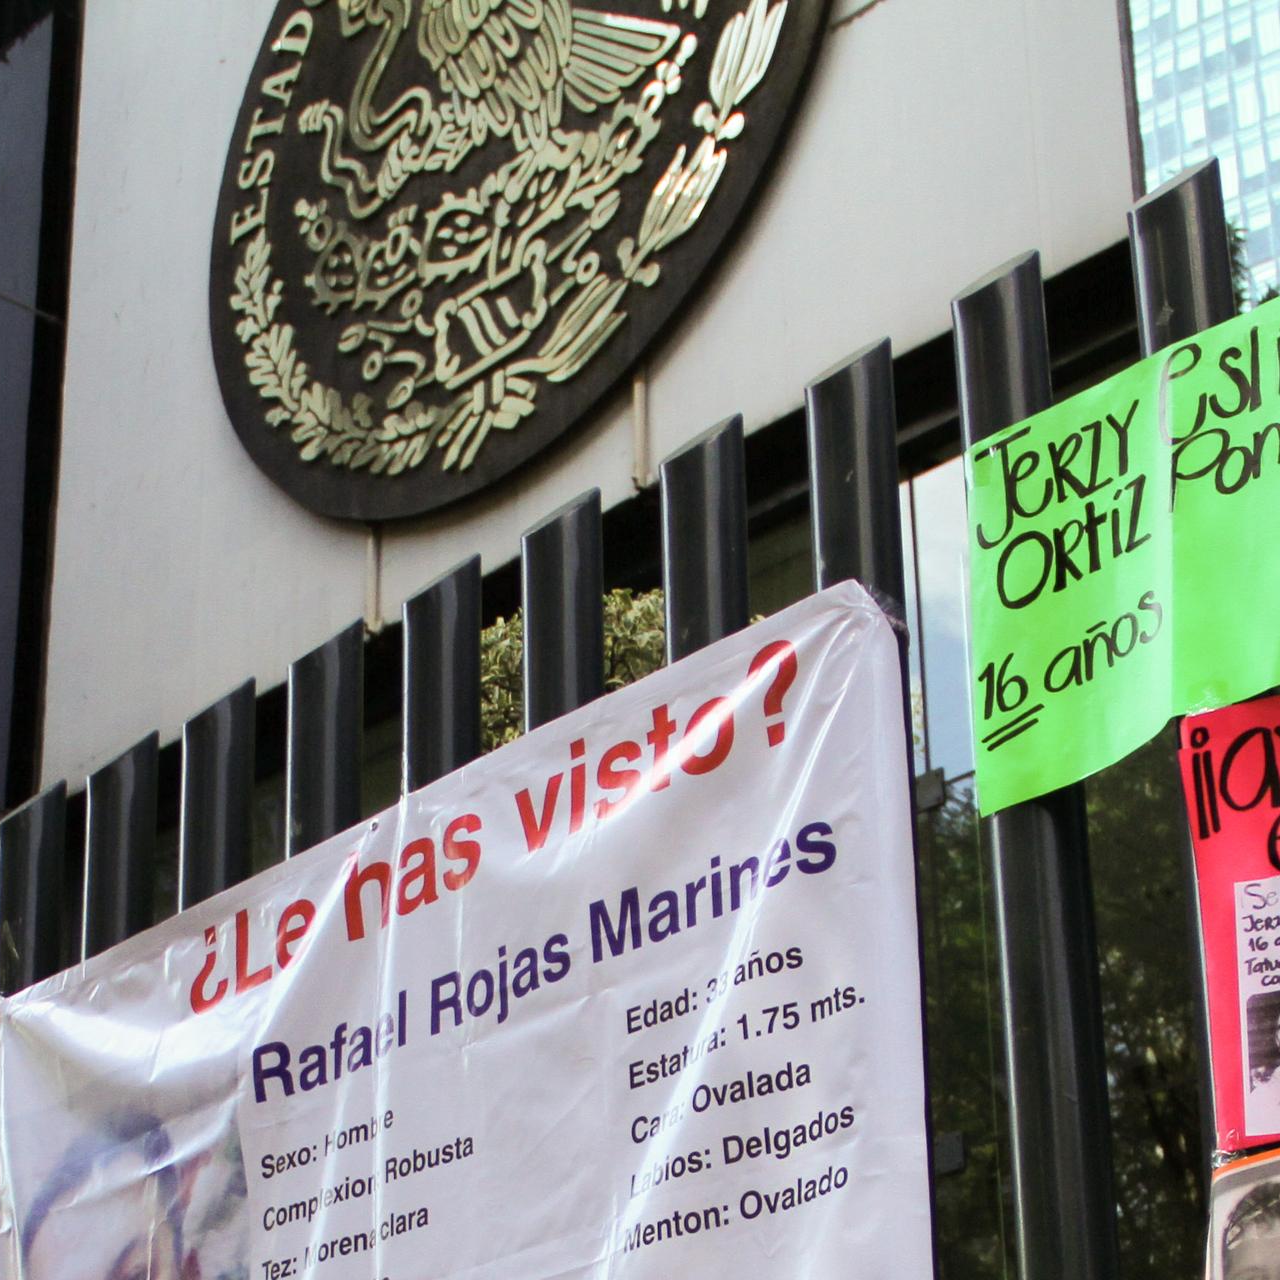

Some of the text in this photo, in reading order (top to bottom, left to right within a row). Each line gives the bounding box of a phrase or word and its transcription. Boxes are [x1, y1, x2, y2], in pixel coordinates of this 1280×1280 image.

[230, 0, 322, 247] ESTAD
[978, 590, 1162, 719] 16 años
[190, 899, 316, 1014] ¿Le
[345, 813, 482, 943] has
[1249, 935, 1268, 952] 16
[252, 821, 838, 1104] Rafael Rojas Marines
[627, 946, 803, 1034] Edad: años
[737, 1002, 800, 1040] 1.75
[811, 985, 865, 1023] mts.
[692, 1061, 811, 1112] Ovalada
[262, 1146, 316, 1179] Sexo:
[385, 1137, 473, 1184] Robusta
[723, 1105, 854, 1165] Delgados
[381, 1207, 428, 1241] clara
[624, 1166, 848, 1254] Menton: Ovalado
